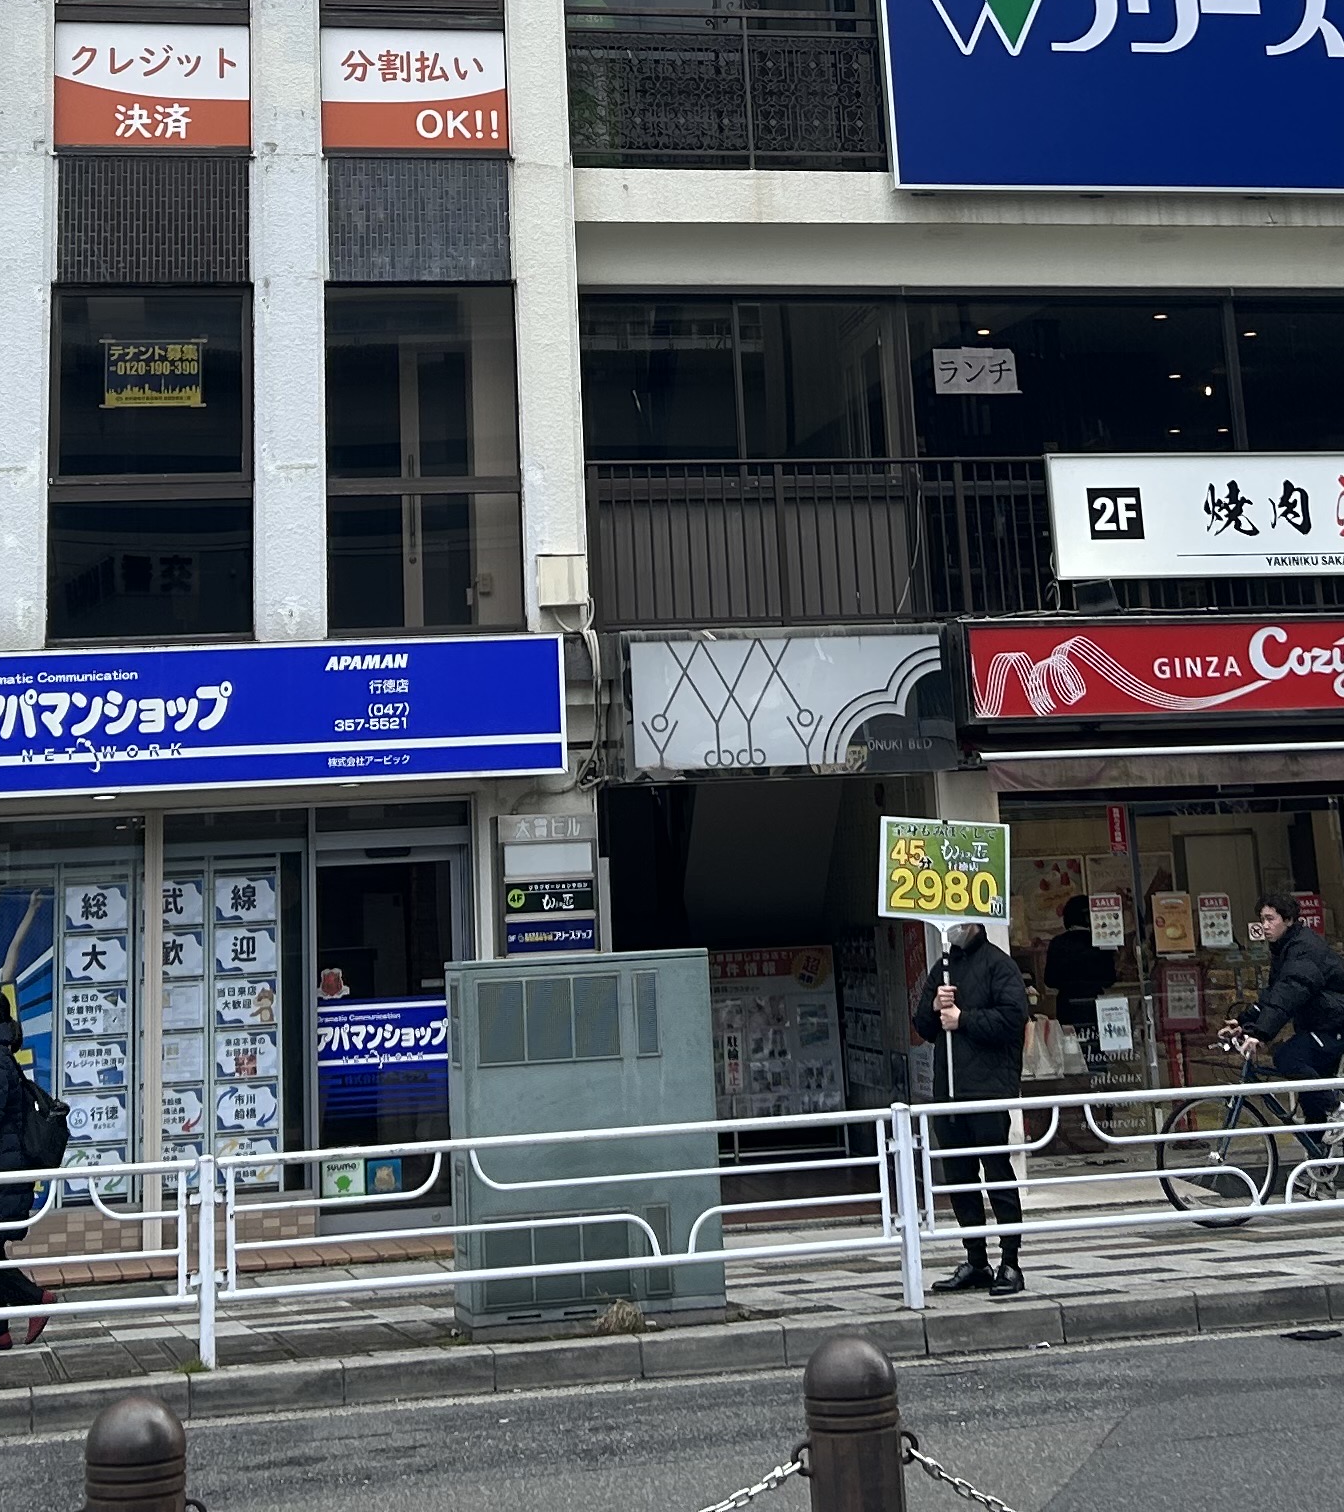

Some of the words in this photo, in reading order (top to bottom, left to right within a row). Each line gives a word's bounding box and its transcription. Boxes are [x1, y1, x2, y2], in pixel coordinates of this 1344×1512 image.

[70, 43, 238, 82] クレジット
[340, 49, 485, 85] 分割払い
[114, 103, 192, 140] 決済
[415, 109, 500, 141] OK!!
[109, 344, 198, 361] テナント募集
[117, 360, 198, 375] 0120-190-390
[937, 359, 1013, 386] ランチ
[1092, 496, 1138, 531] 2F
[1204, 480, 1313, 537] 焼肉
[1266, 556, 1318, 567] YAKINIKU
[324, 654, 409, 671] APAMAN
[1153, 655, 1242, 680] GINZA
[36, 669, 138, 684] Communication
[369, 679, 409, 694] 行徳店
[368, 702, 410, 717] (047)
[334, 717, 408, 732] 357-5521
[516, 817, 581, 839] 大貫ビル
[81, 892, 107, 921] 総
[162, 887, 184, 915] 武
[231, 885, 257, 912] 線
[509, 893, 523, 903] 4F
[1094, 897, 1116, 907] SALE
[1203, 897, 1224, 906] SALE
[81, 944, 107, 972] 大
[231, 936, 257, 963] 迎
[72, 993, 99, 1004] 本日の
[217, 985, 257, 997] 当日来店
[66, 1005, 103, 1016] 新着物件
[222, 998, 252, 1010] 大歓迎
[72, 1017, 98, 1027] コチラ
[317, 1018, 449, 1053] アパマンショップ
[234, 1093, 256, 1106] 市川
[89, 1106, 119, 1122] 行徳
